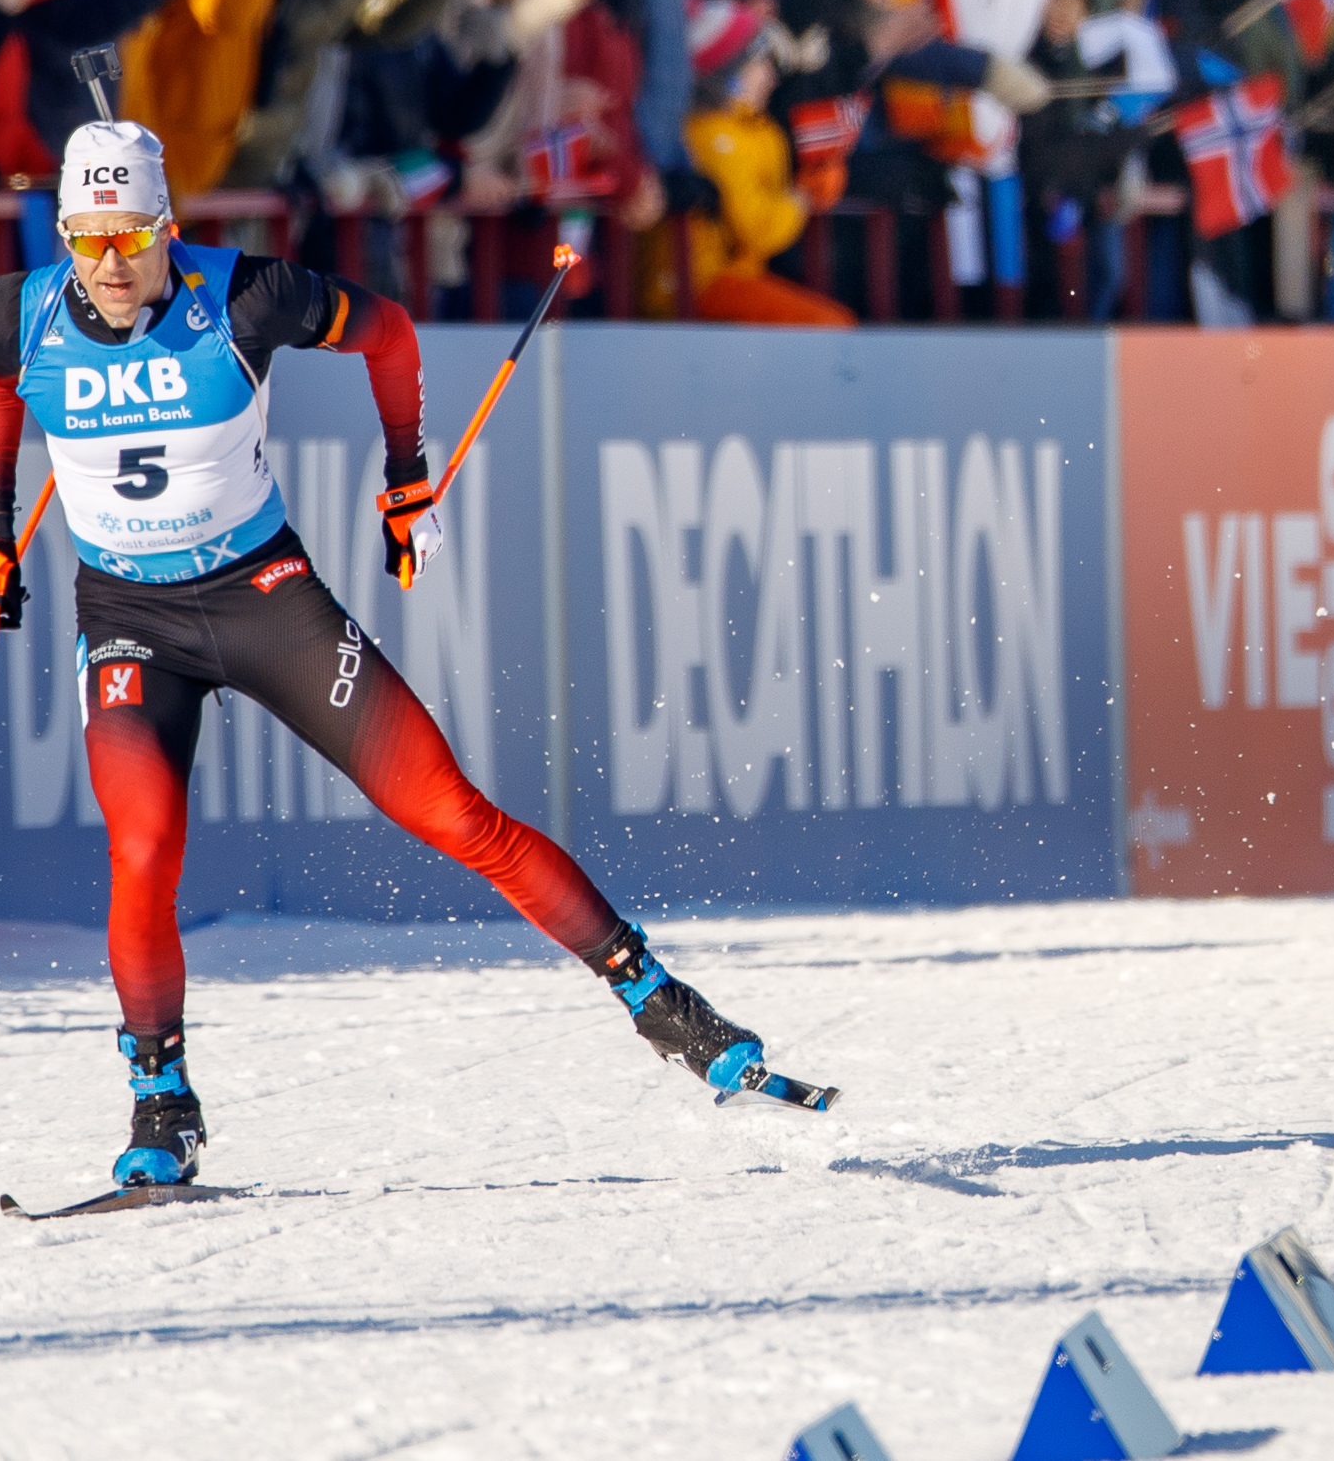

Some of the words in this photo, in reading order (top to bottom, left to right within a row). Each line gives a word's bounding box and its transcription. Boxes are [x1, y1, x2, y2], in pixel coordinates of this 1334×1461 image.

[82, 161, 129, 186] ice
[65, 357, 188, 410] DKB
[65, 415, 98, 430] Das
[102, 408, 144, 426] kann
[148, 405, 193, 421] Bank
[112, 445, 169, 501] 5
[127, 508, 213, 533] Otepää
[599, 433, 1069, 820] DECATHLON
[329, 620, 362, 708] odlo
